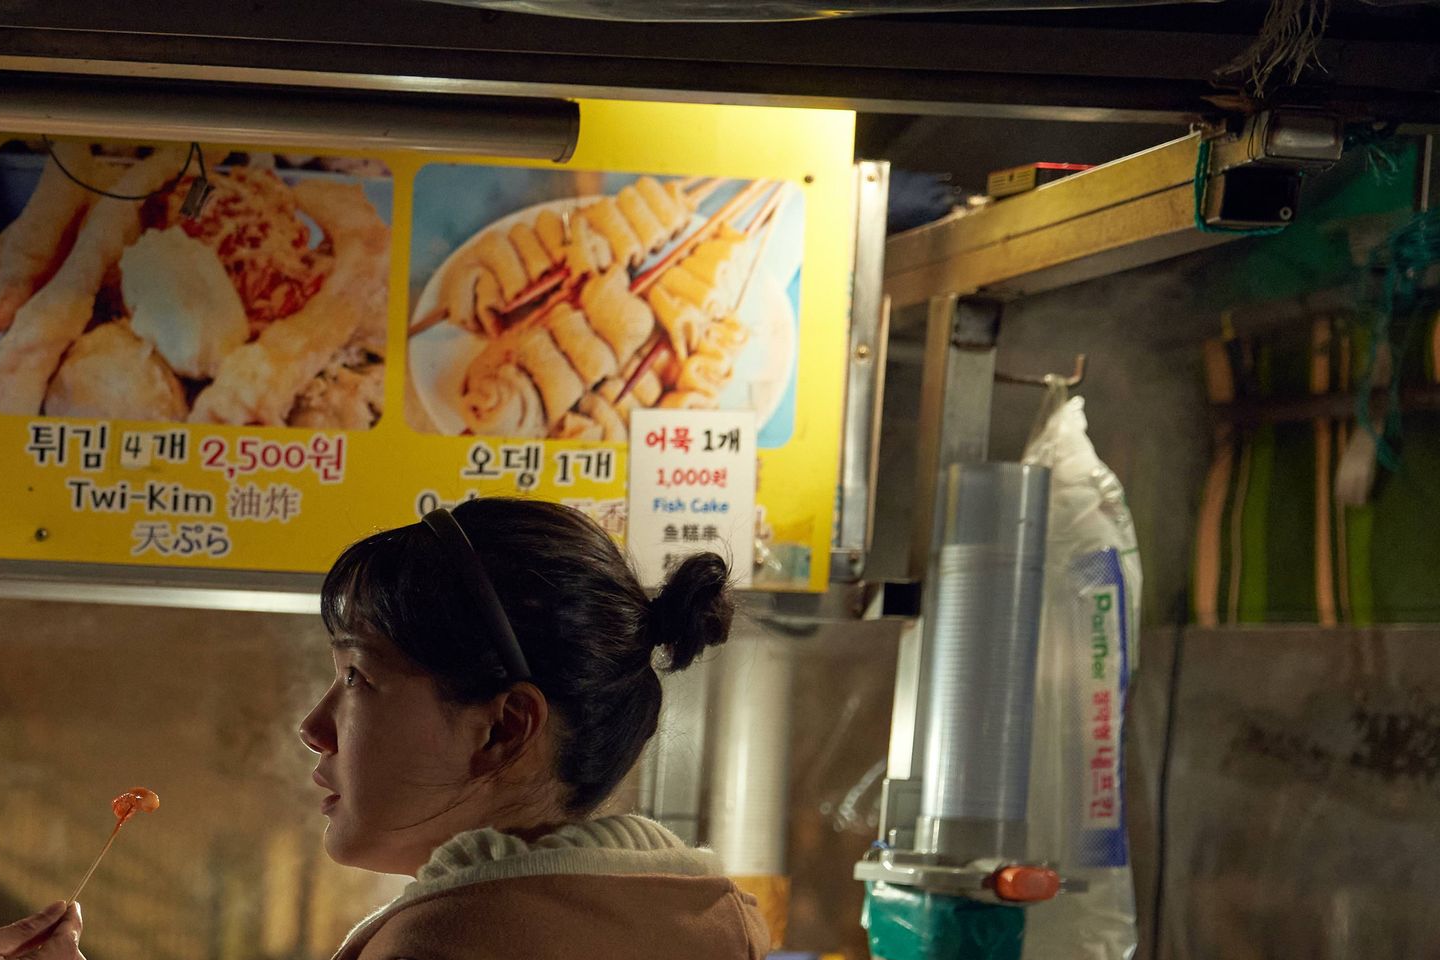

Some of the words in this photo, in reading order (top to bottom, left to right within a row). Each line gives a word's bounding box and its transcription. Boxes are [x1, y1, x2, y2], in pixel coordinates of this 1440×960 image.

[28, 425, 107, 469] 튀김
[202, 435, 346, 481] 2,500원
[645, 427, 692, 452] 어묵
[702, 428, 740, 453] 1개
[462, 444, 542, 487] 오뎅
[556, 451, 612, 483] 1개
[656, 467, 728, 489] 1,000원
[68, 481, 213, 514] Twi-Kim
[228, 485, 300, 521] 油炸
[652, 497, 686, 513] Fish
[691, 497, 729, 514] Cake
[133, 524, 230, 557] 天ぷら
